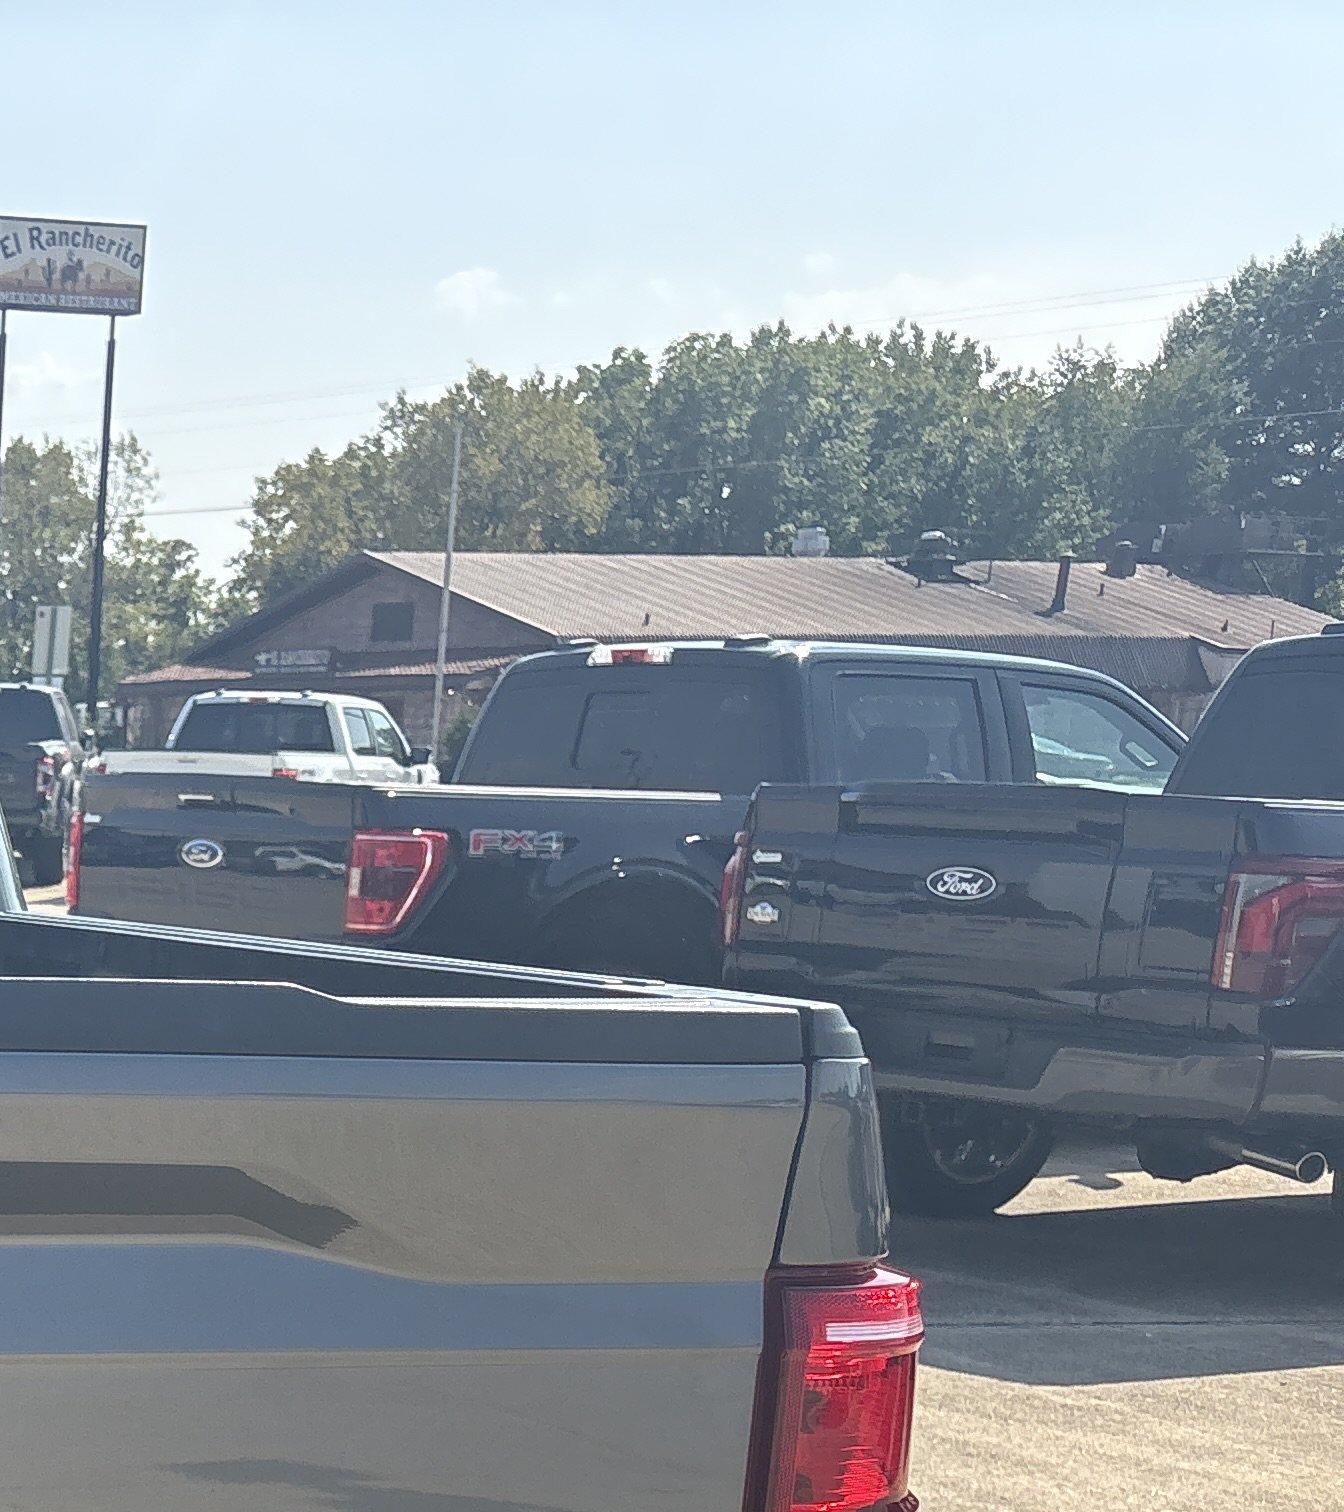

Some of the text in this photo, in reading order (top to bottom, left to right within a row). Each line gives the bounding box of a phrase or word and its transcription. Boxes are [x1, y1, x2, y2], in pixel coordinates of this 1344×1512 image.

[27, 226, 143, 270] Rancherito
[0, 291, 137, 311] MEXICAN RESTAURANT
[469, 829, 565, 860] FX4
[936, 871, 984, 894] Ford
